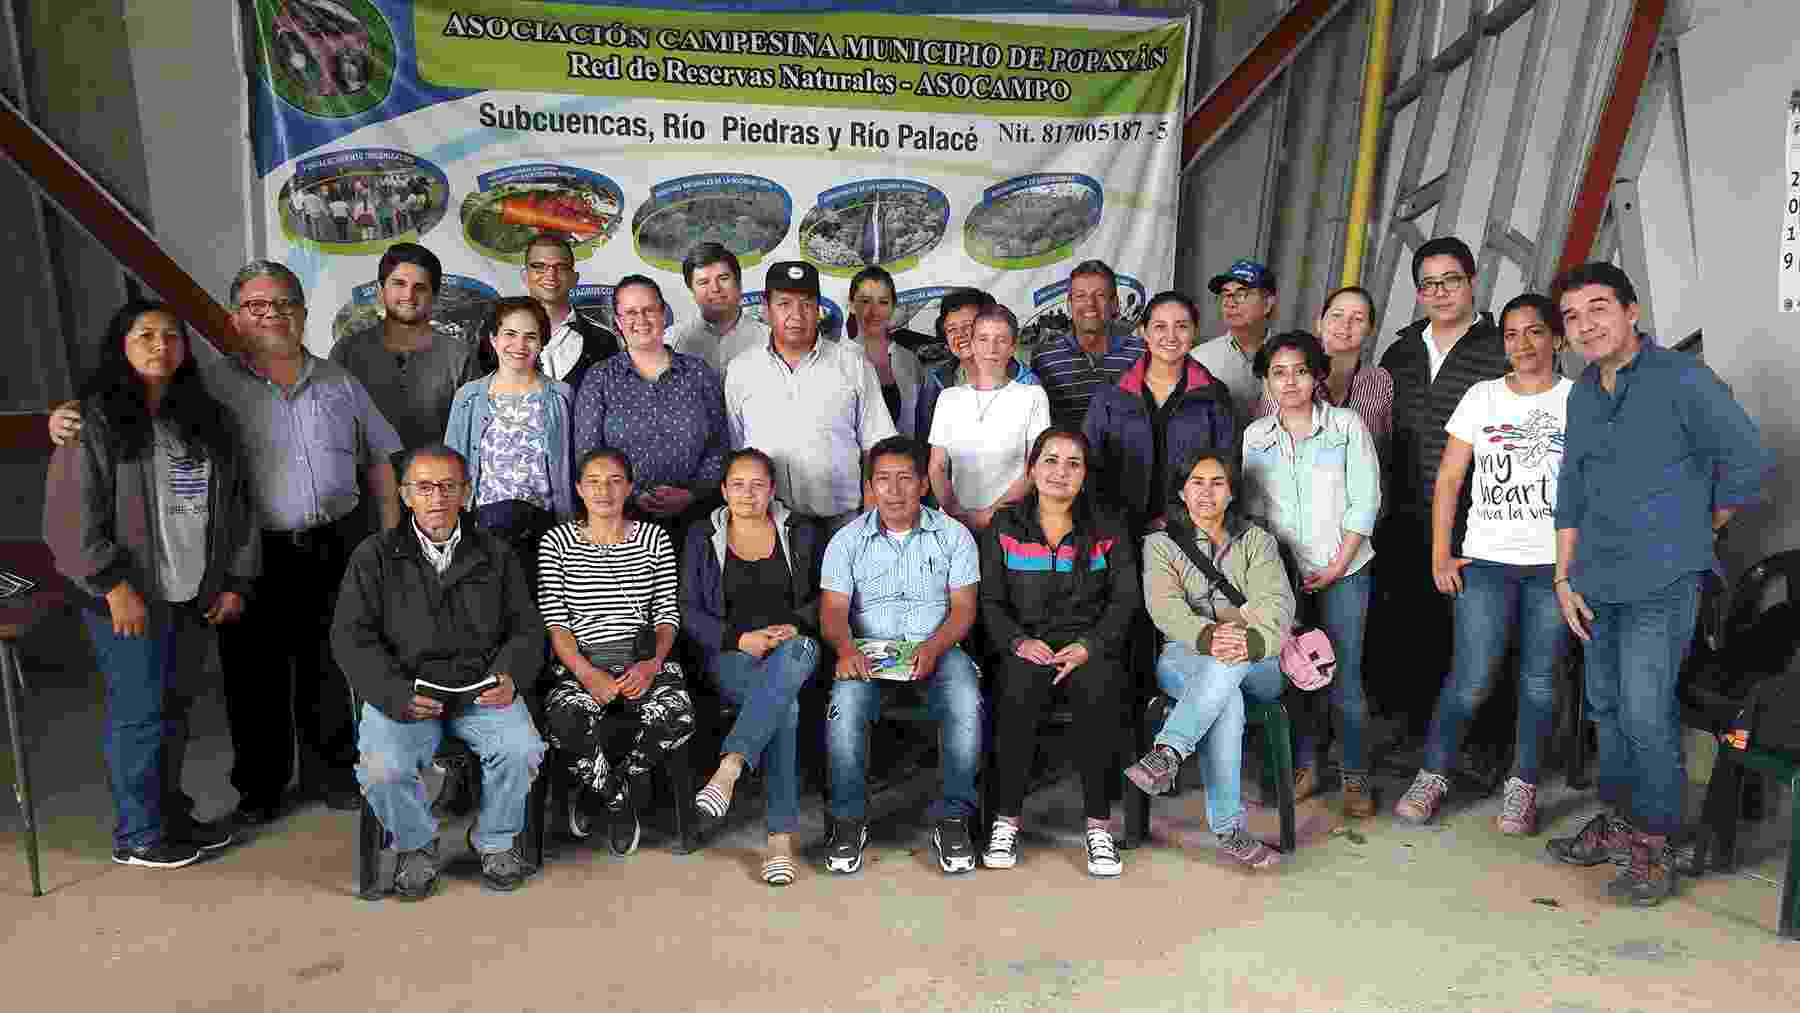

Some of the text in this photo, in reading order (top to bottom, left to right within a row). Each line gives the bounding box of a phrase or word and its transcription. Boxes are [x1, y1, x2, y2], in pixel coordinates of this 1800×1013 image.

[444, 12, 1168, 72] ASOCIACIÓN CAMPESINA MUNICIPIO DE POPAYÁN
[567, 52, 621, 79] Red
[627, 56, 658, 81] de
[663, 57, 774, 88] Reservas
[778, 63, 897, 94] Naturales
[914, 71, 1072, 102] ASOCAMPO
[479, 102, 978, 152] Subcuencas, Río Piedras y Río Palacé
[999, 122, 1035, 143] Nit.
[1479, 474, 1551, 506] heart
